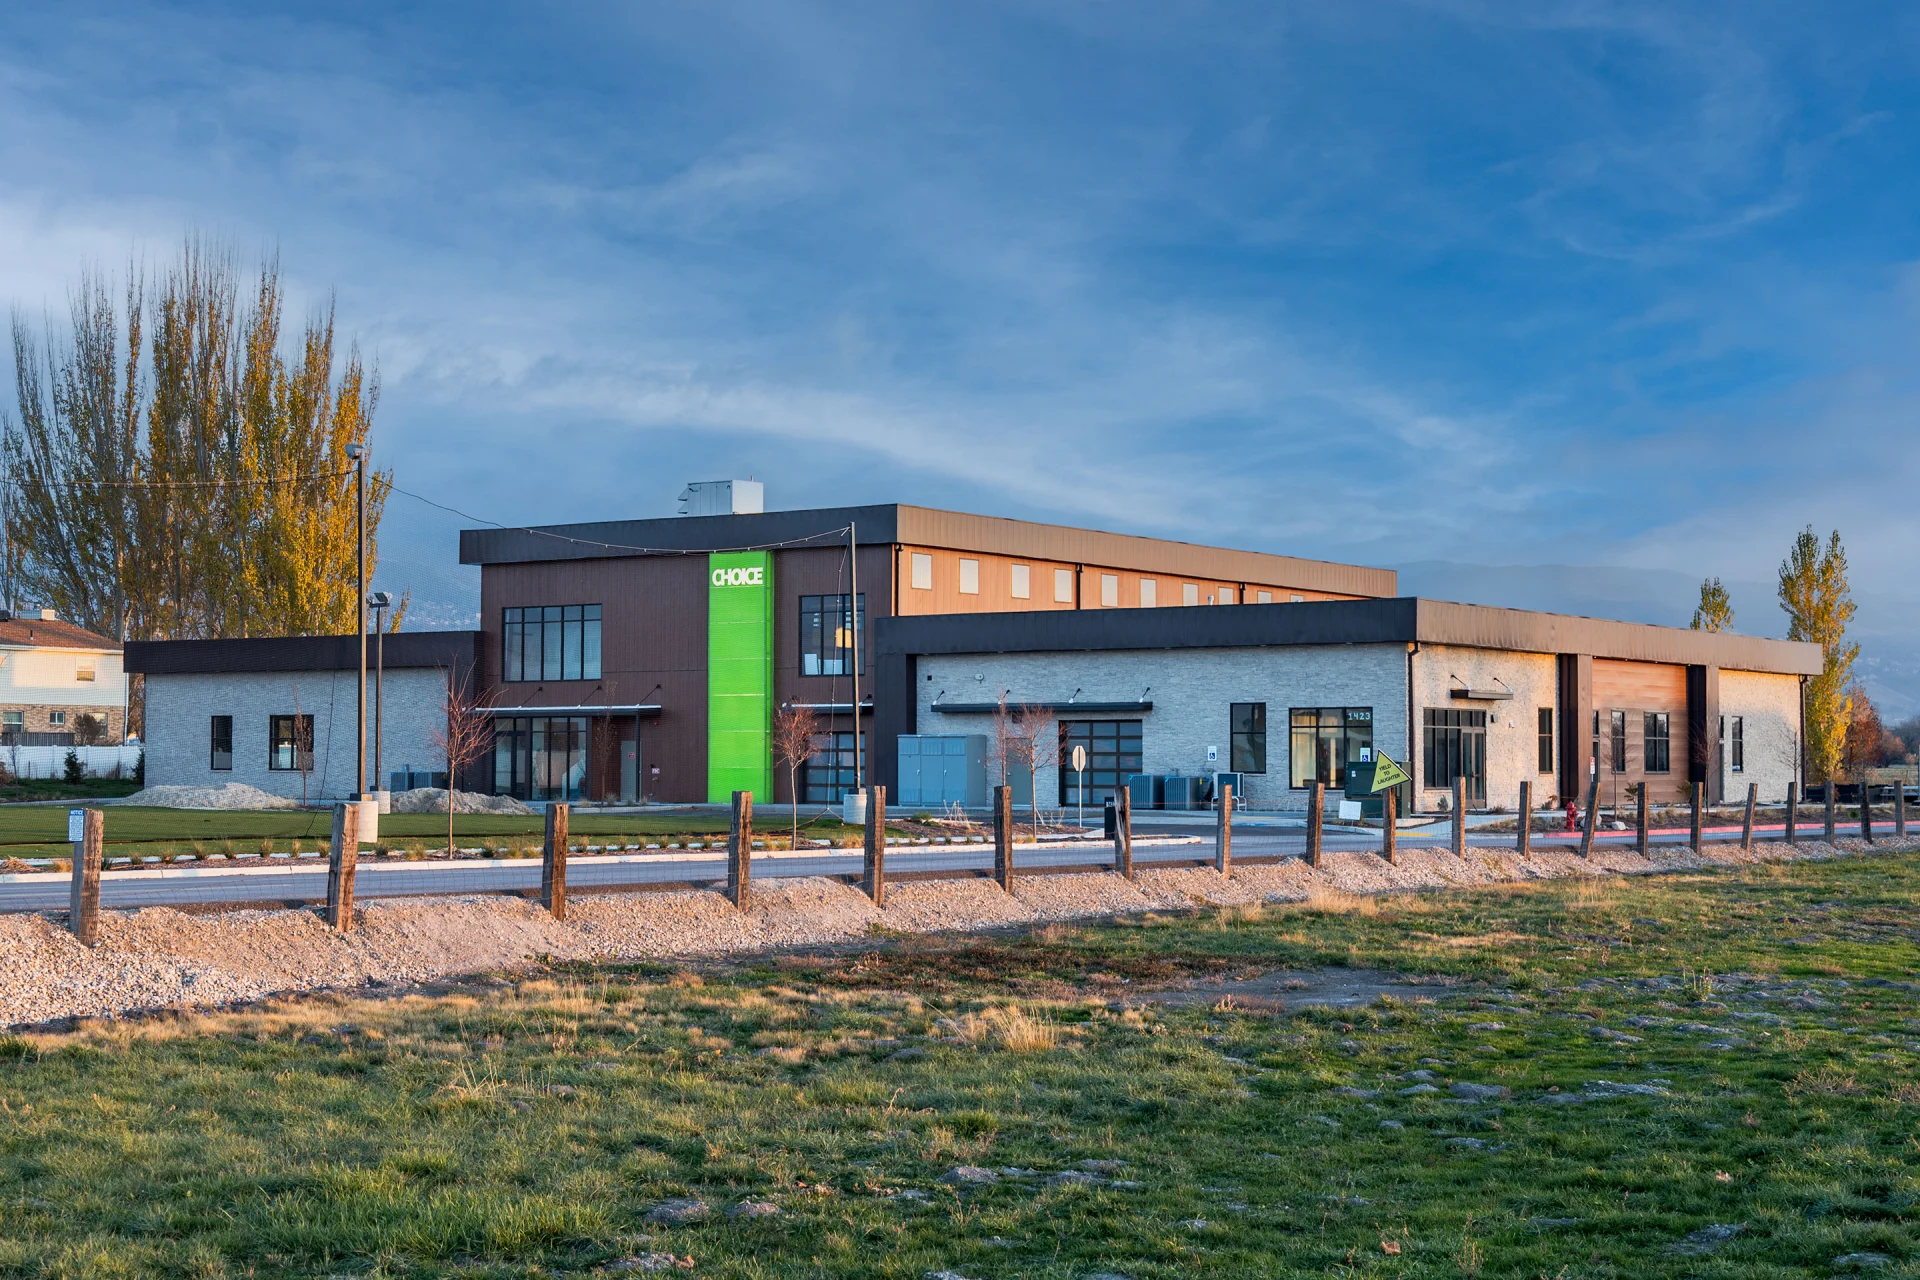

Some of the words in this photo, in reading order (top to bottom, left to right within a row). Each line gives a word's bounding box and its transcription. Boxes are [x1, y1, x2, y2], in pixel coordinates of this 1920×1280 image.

[712, 567, 763, 586] CHOICE
[1348, 712, 1371, 721] 1423
[1379, 763, 1392, 772] YIELD
[1377, 773, 1400, 784] LAUGHTER
